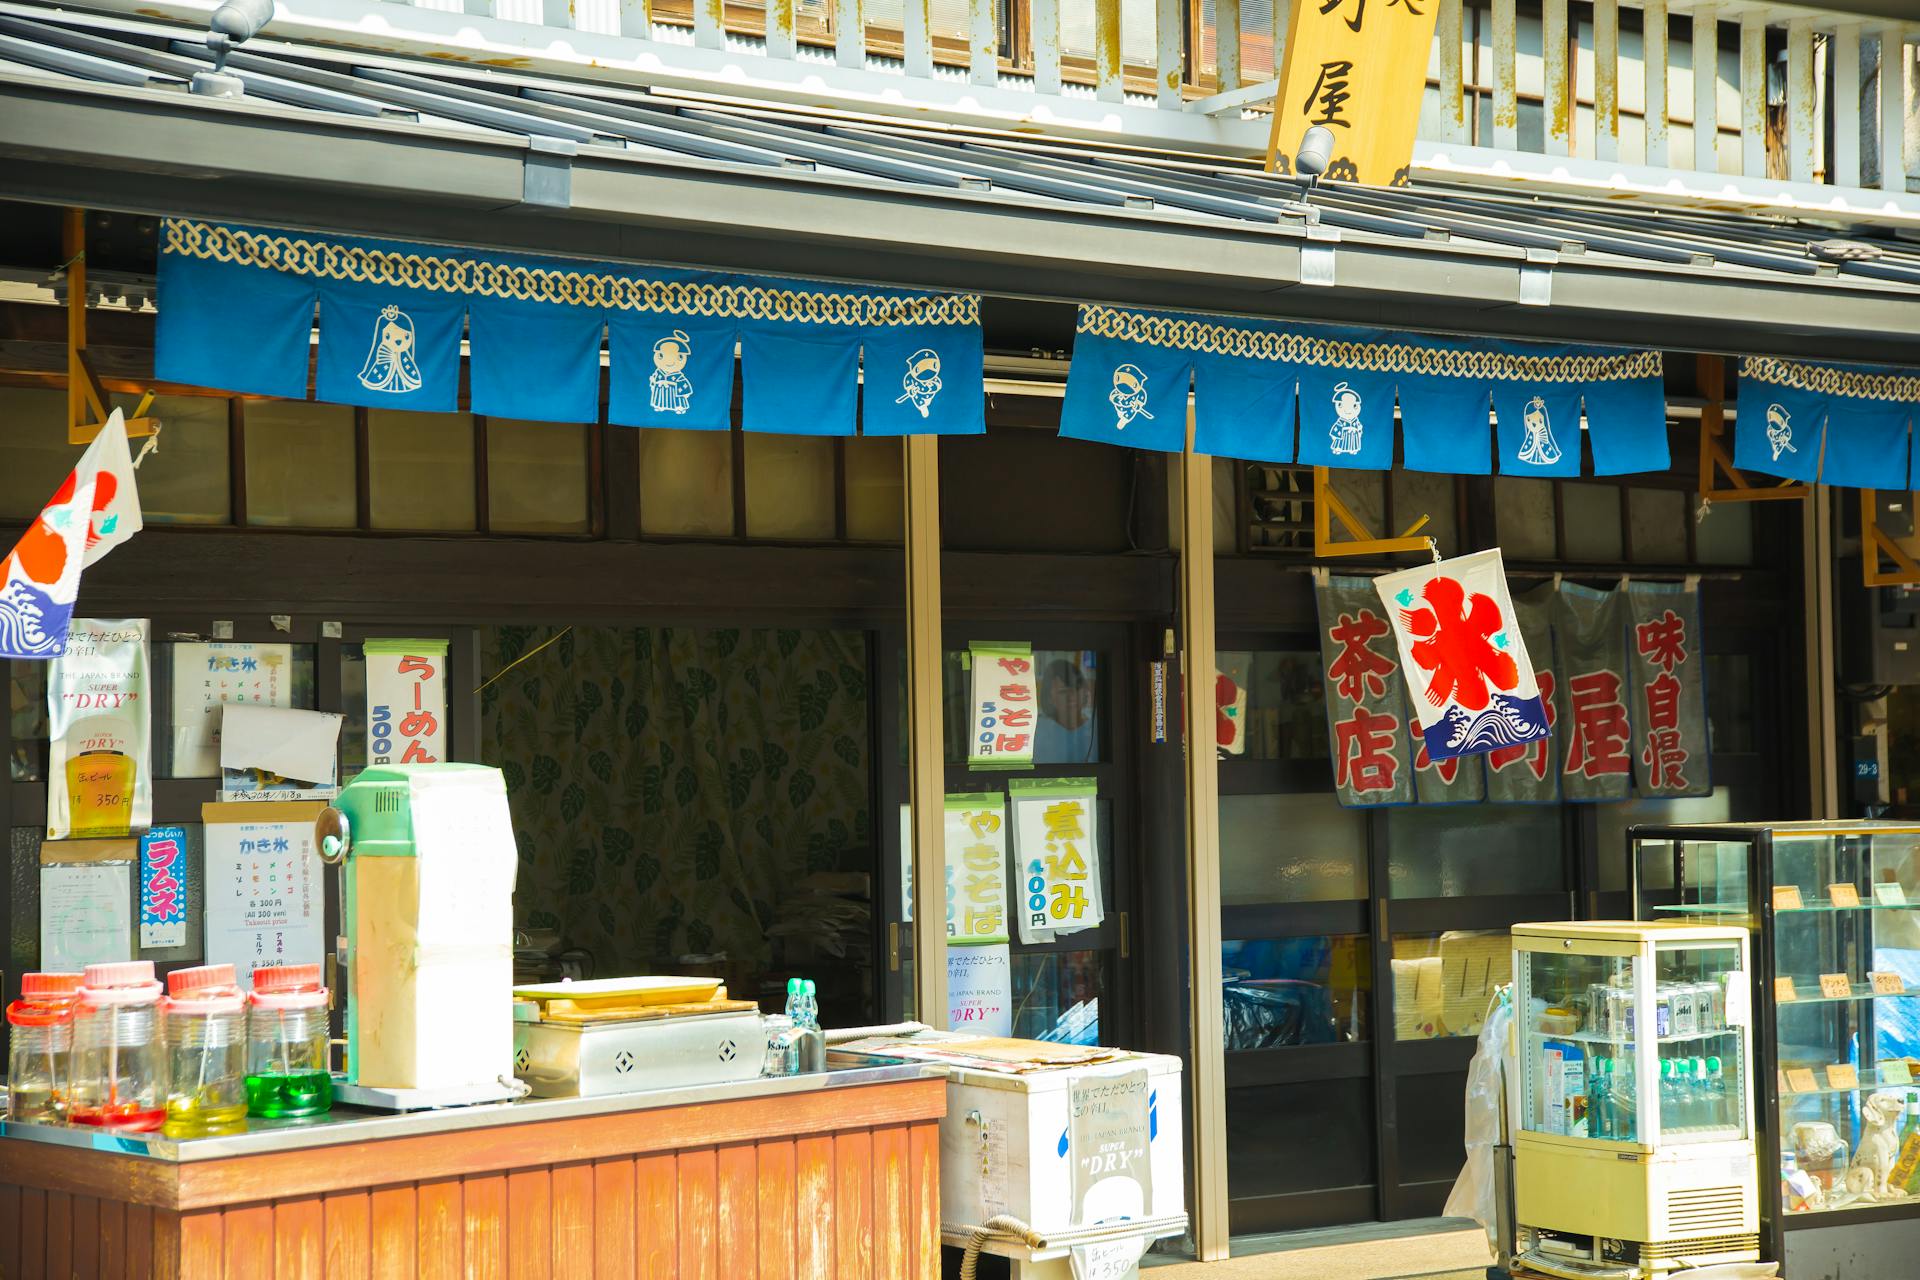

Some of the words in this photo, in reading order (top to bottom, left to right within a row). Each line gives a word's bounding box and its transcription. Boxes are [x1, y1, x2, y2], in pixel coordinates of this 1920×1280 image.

[80, 672, 107, 680] JAPAN
[110, 672, 140, 680] BRAND
[208, 656, 257, 672] かき氷
[1398, 577, 1519, 711] 氷
[88, 683, 118, 691] SUPER
[398, 655, 437, 764] らーめん
[996, 657, 1032, 752] やきそば
[1328, 608, 1399, 795] 茶店
[1636, 609, 1690, 789] 味自慢
[979, 702, 997, 755] 500円
[1858, 764, 1878, 775] 29-3
[240, 837, 289, 854] かき氷
[1043, 801, 1089, 920] 煮込み
[147, 839, 179, 921] ラムネ
[1028, 859, 1046, 926] 400円
[1099, 1141, 1126, 1152] SUPER
